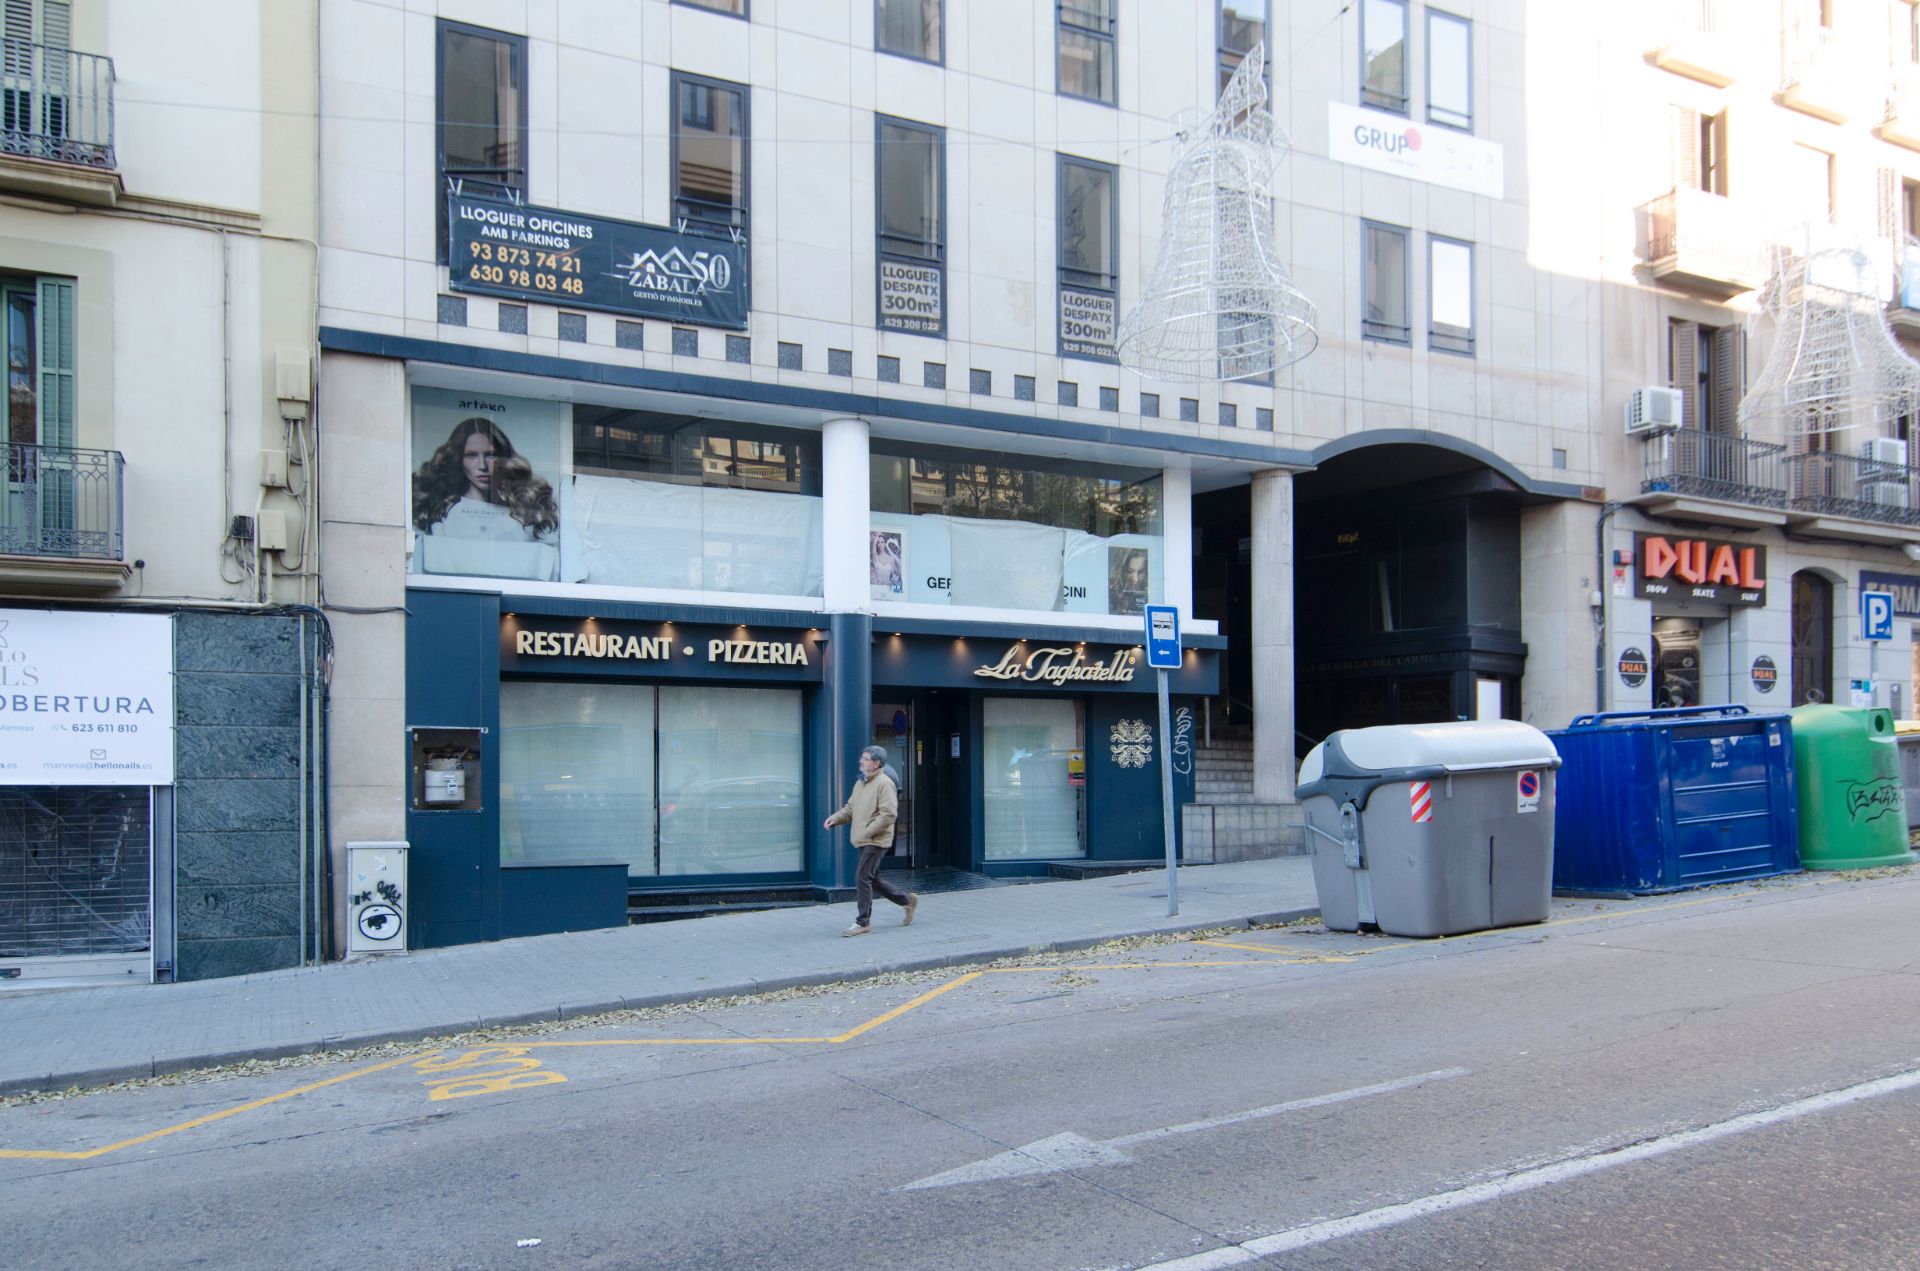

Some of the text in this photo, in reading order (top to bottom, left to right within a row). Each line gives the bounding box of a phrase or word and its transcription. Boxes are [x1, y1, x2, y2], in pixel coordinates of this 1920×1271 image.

[1354, 125, 1408, 154] GRUP
[461, 205, 593, 239] LLOGUER OFICINES
[481, 225, 570, 249] AMB PARKINGS
[470, 241, 580, 273] 93 873 74 21
[470, 264, 583, 294] 630 98 03 48
[629, 271, 707, 296] ZABALA
[882, 266, 938, 283] LLOGUER
[883, 280, 938, 296] DESPATX
[1063, 294, 1112, 311] LLOGUER
[1064, 307, 1112, 324] DESPATX
[1645, 536, 1765, 589] DUAL
[1692, 588, 1717, 599] SKATE
[1869, 598, 1888, 635] P
[516, 630, 809, 666] RESTAURANT PIZZERIA
[974, 645, 1135, 686] La Tagliatella
[1621, 662, 1645, 673] DUAL
[1753, 670, 1775, 680] DUAL
[72, 723, 94, 733] 623
[97, 724, 114, 733] 611
[117, 724, 138, 733] 810
[42, 761, 152, 771] manresa@hellonails.es
[412, 1047, 568, 1101] BUS
